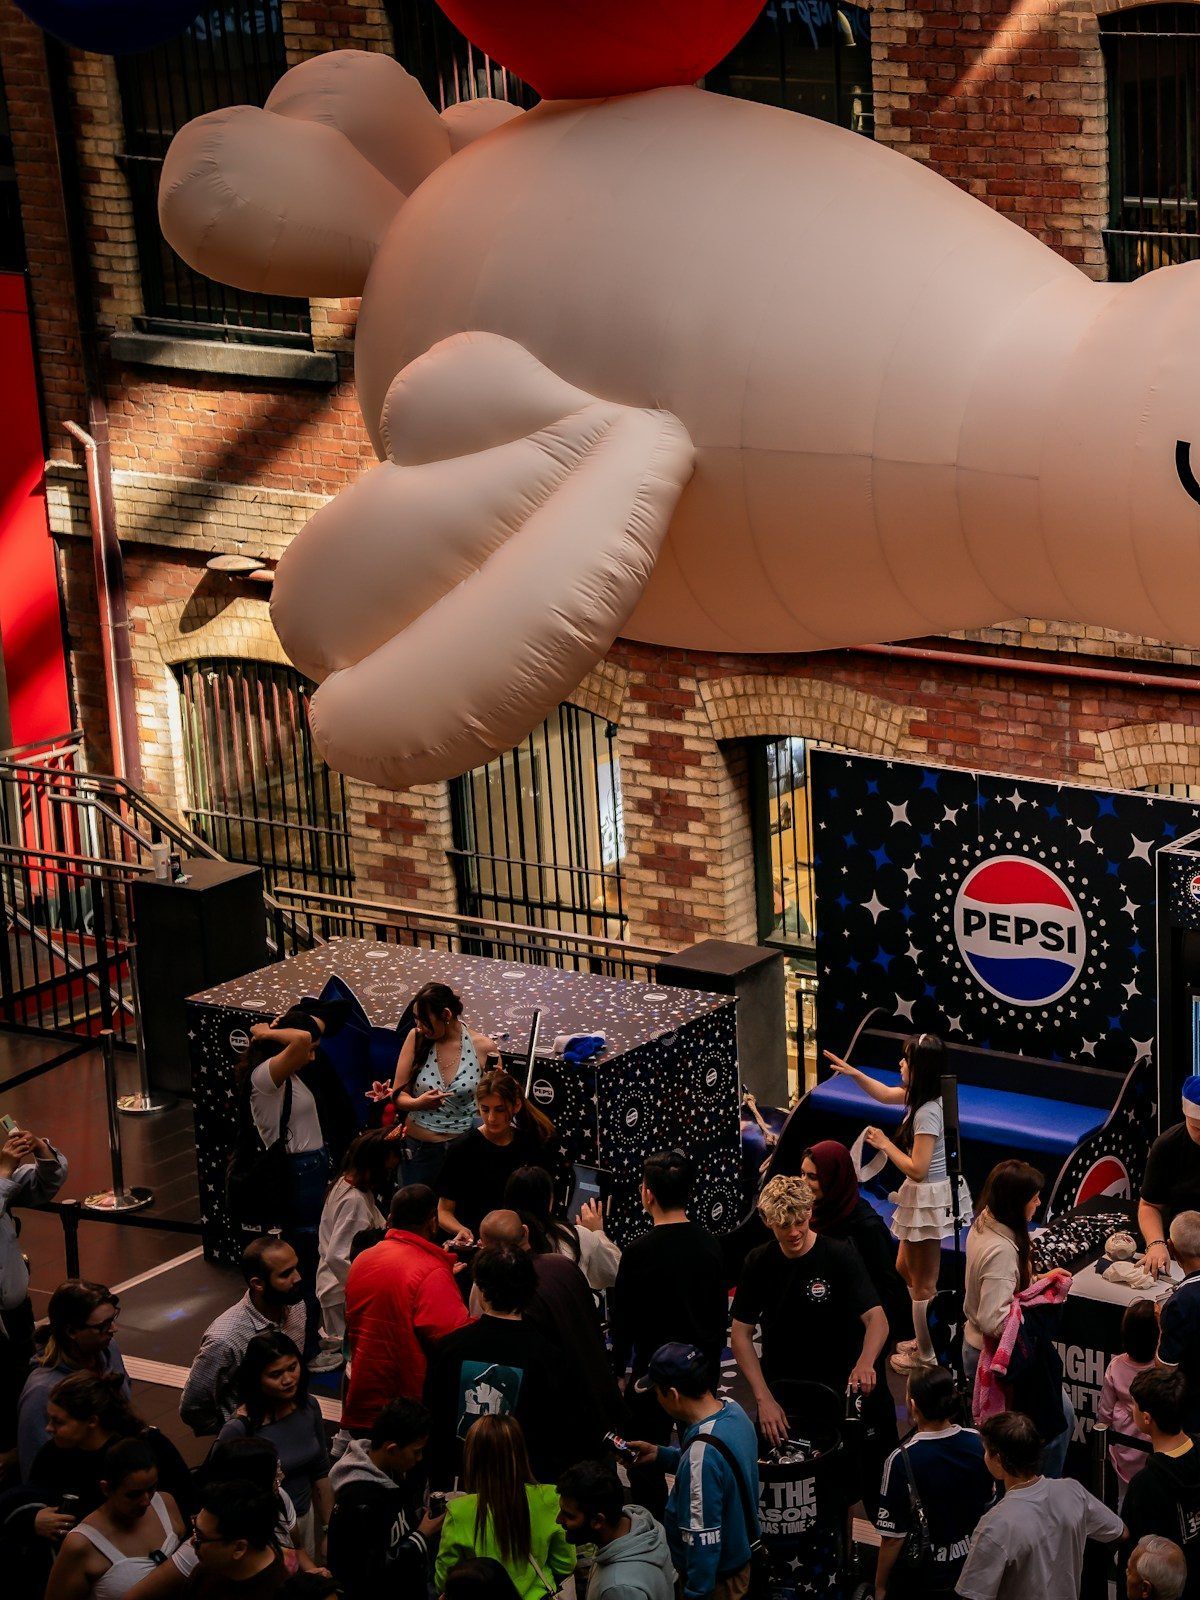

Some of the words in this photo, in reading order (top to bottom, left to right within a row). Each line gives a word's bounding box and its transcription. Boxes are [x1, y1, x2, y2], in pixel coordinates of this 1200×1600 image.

[963, 907, 1077, 954] PEPSI
[534, 1087, 553, 1096] PEPSI
[1051, 1340, 1105, 1388] IGH
[769, 1476, 817, 1508] THE
[780, 1519, 807, 1535] TIME
